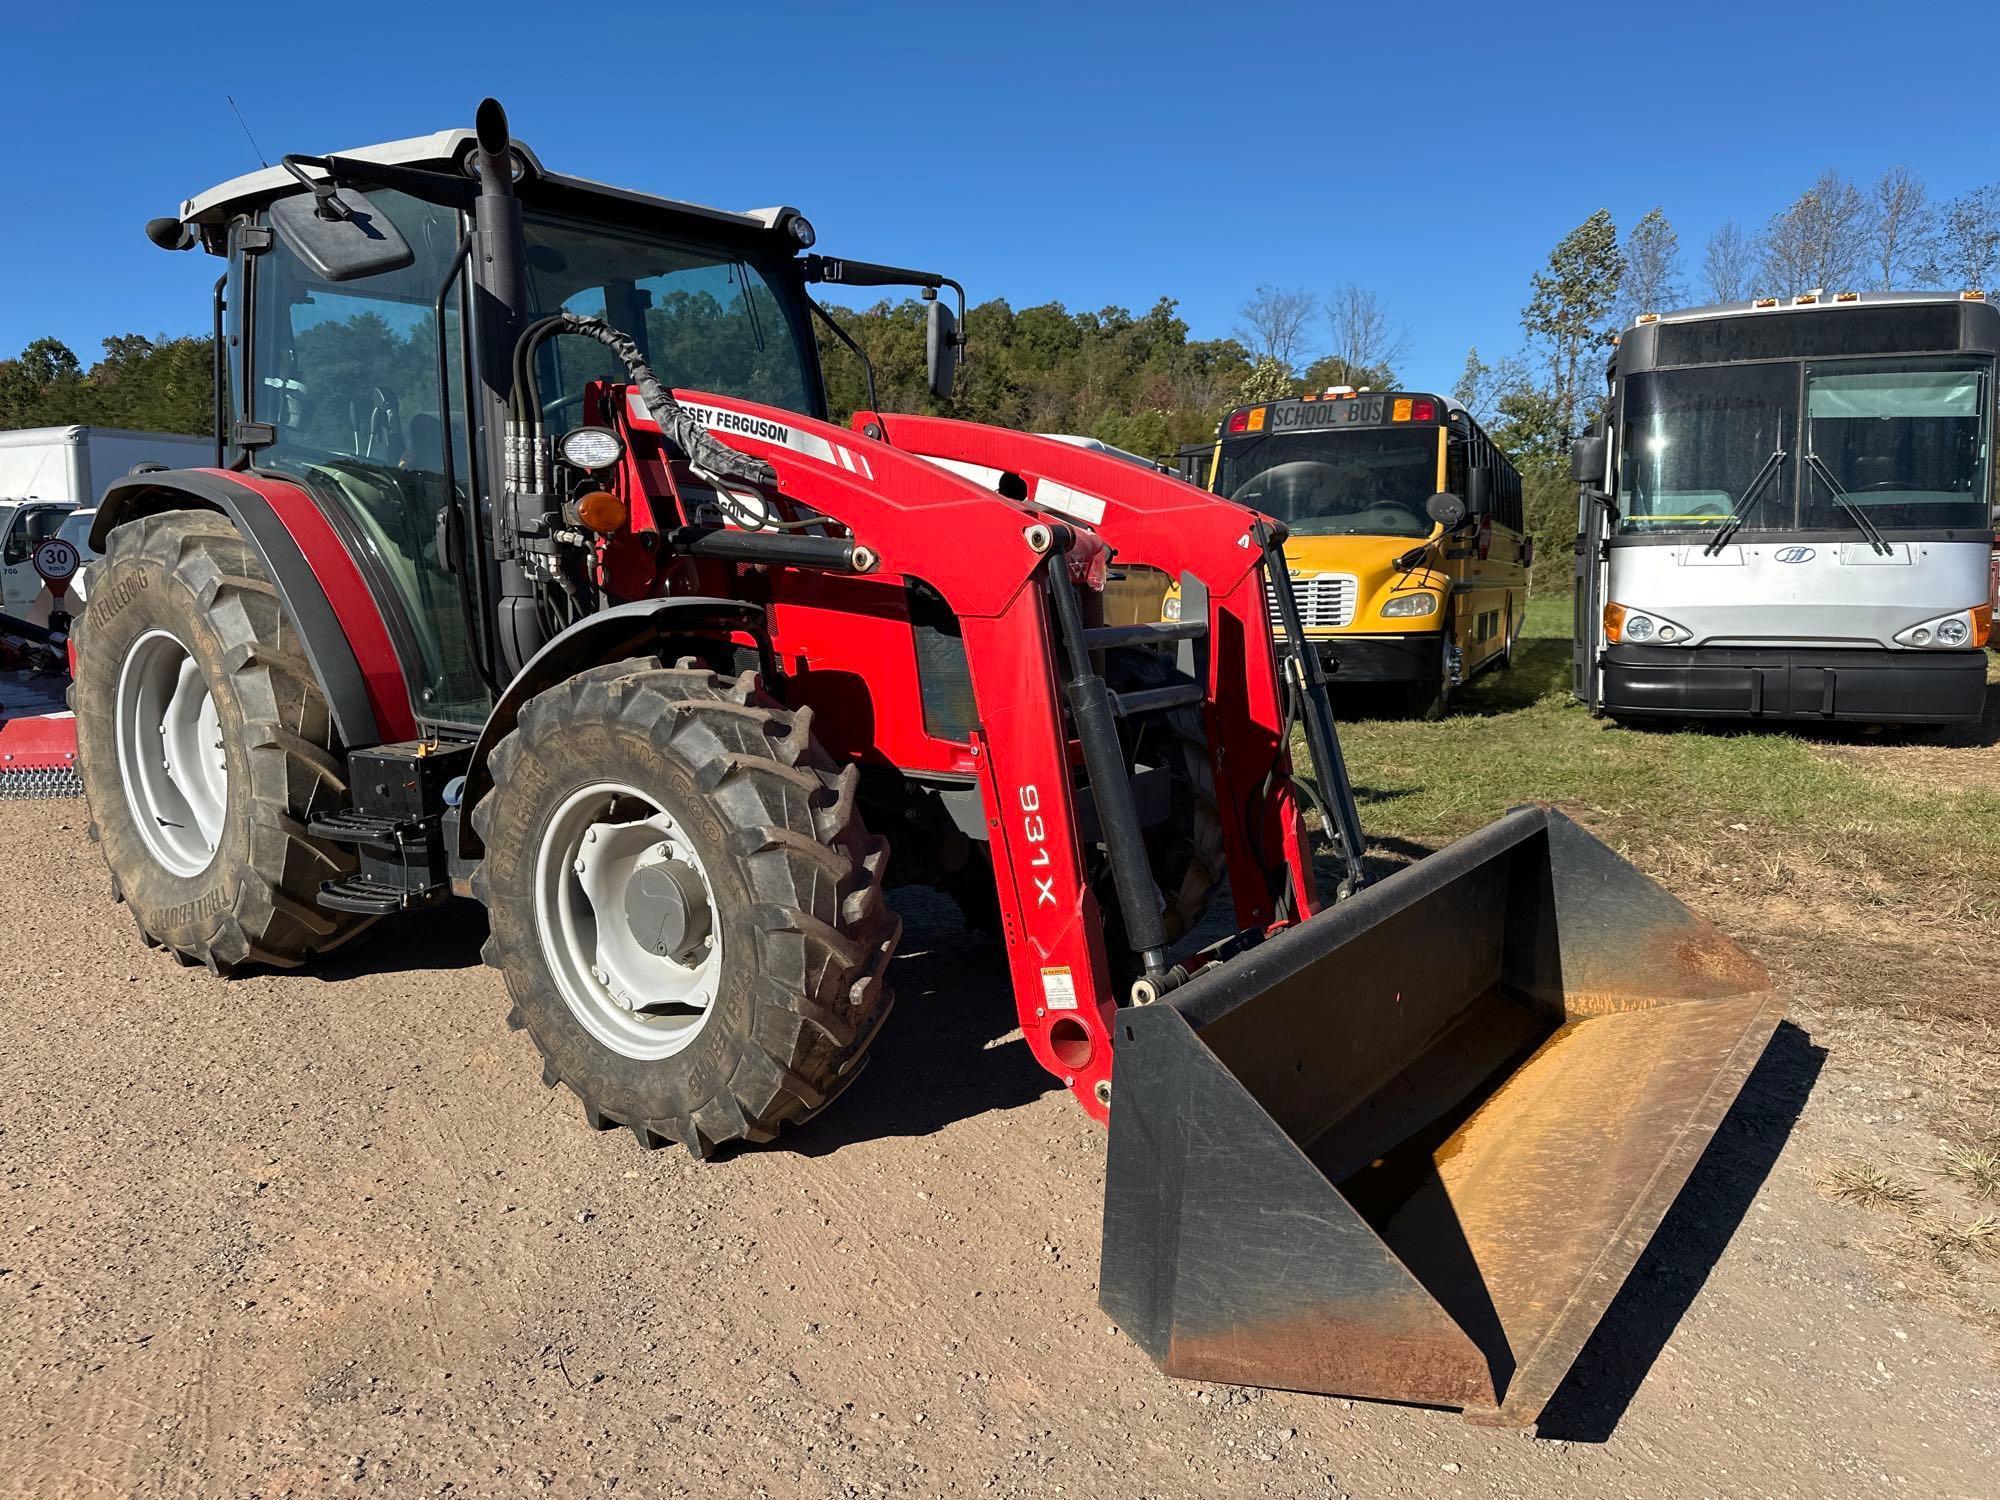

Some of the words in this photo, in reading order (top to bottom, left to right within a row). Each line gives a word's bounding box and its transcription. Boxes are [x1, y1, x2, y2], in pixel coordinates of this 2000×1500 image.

[716, 411, 789, 444] FERGUSON
[1274, 404, 1337, 427] SCHOOL
[1348, 401, 1383, 422] BUS
[45, 549, 68, 565] 30
[87, 565, 149, 633] TRELLEBORG
[616, 735, 664, 778] TM
[671, 773, 721, 843] 600
[493, 758, 550, 881] TRELLEBORG
[150, 884, 232, 932] TRELLEBORG
[688, 969, 753, 1098] TRELLEBORG
